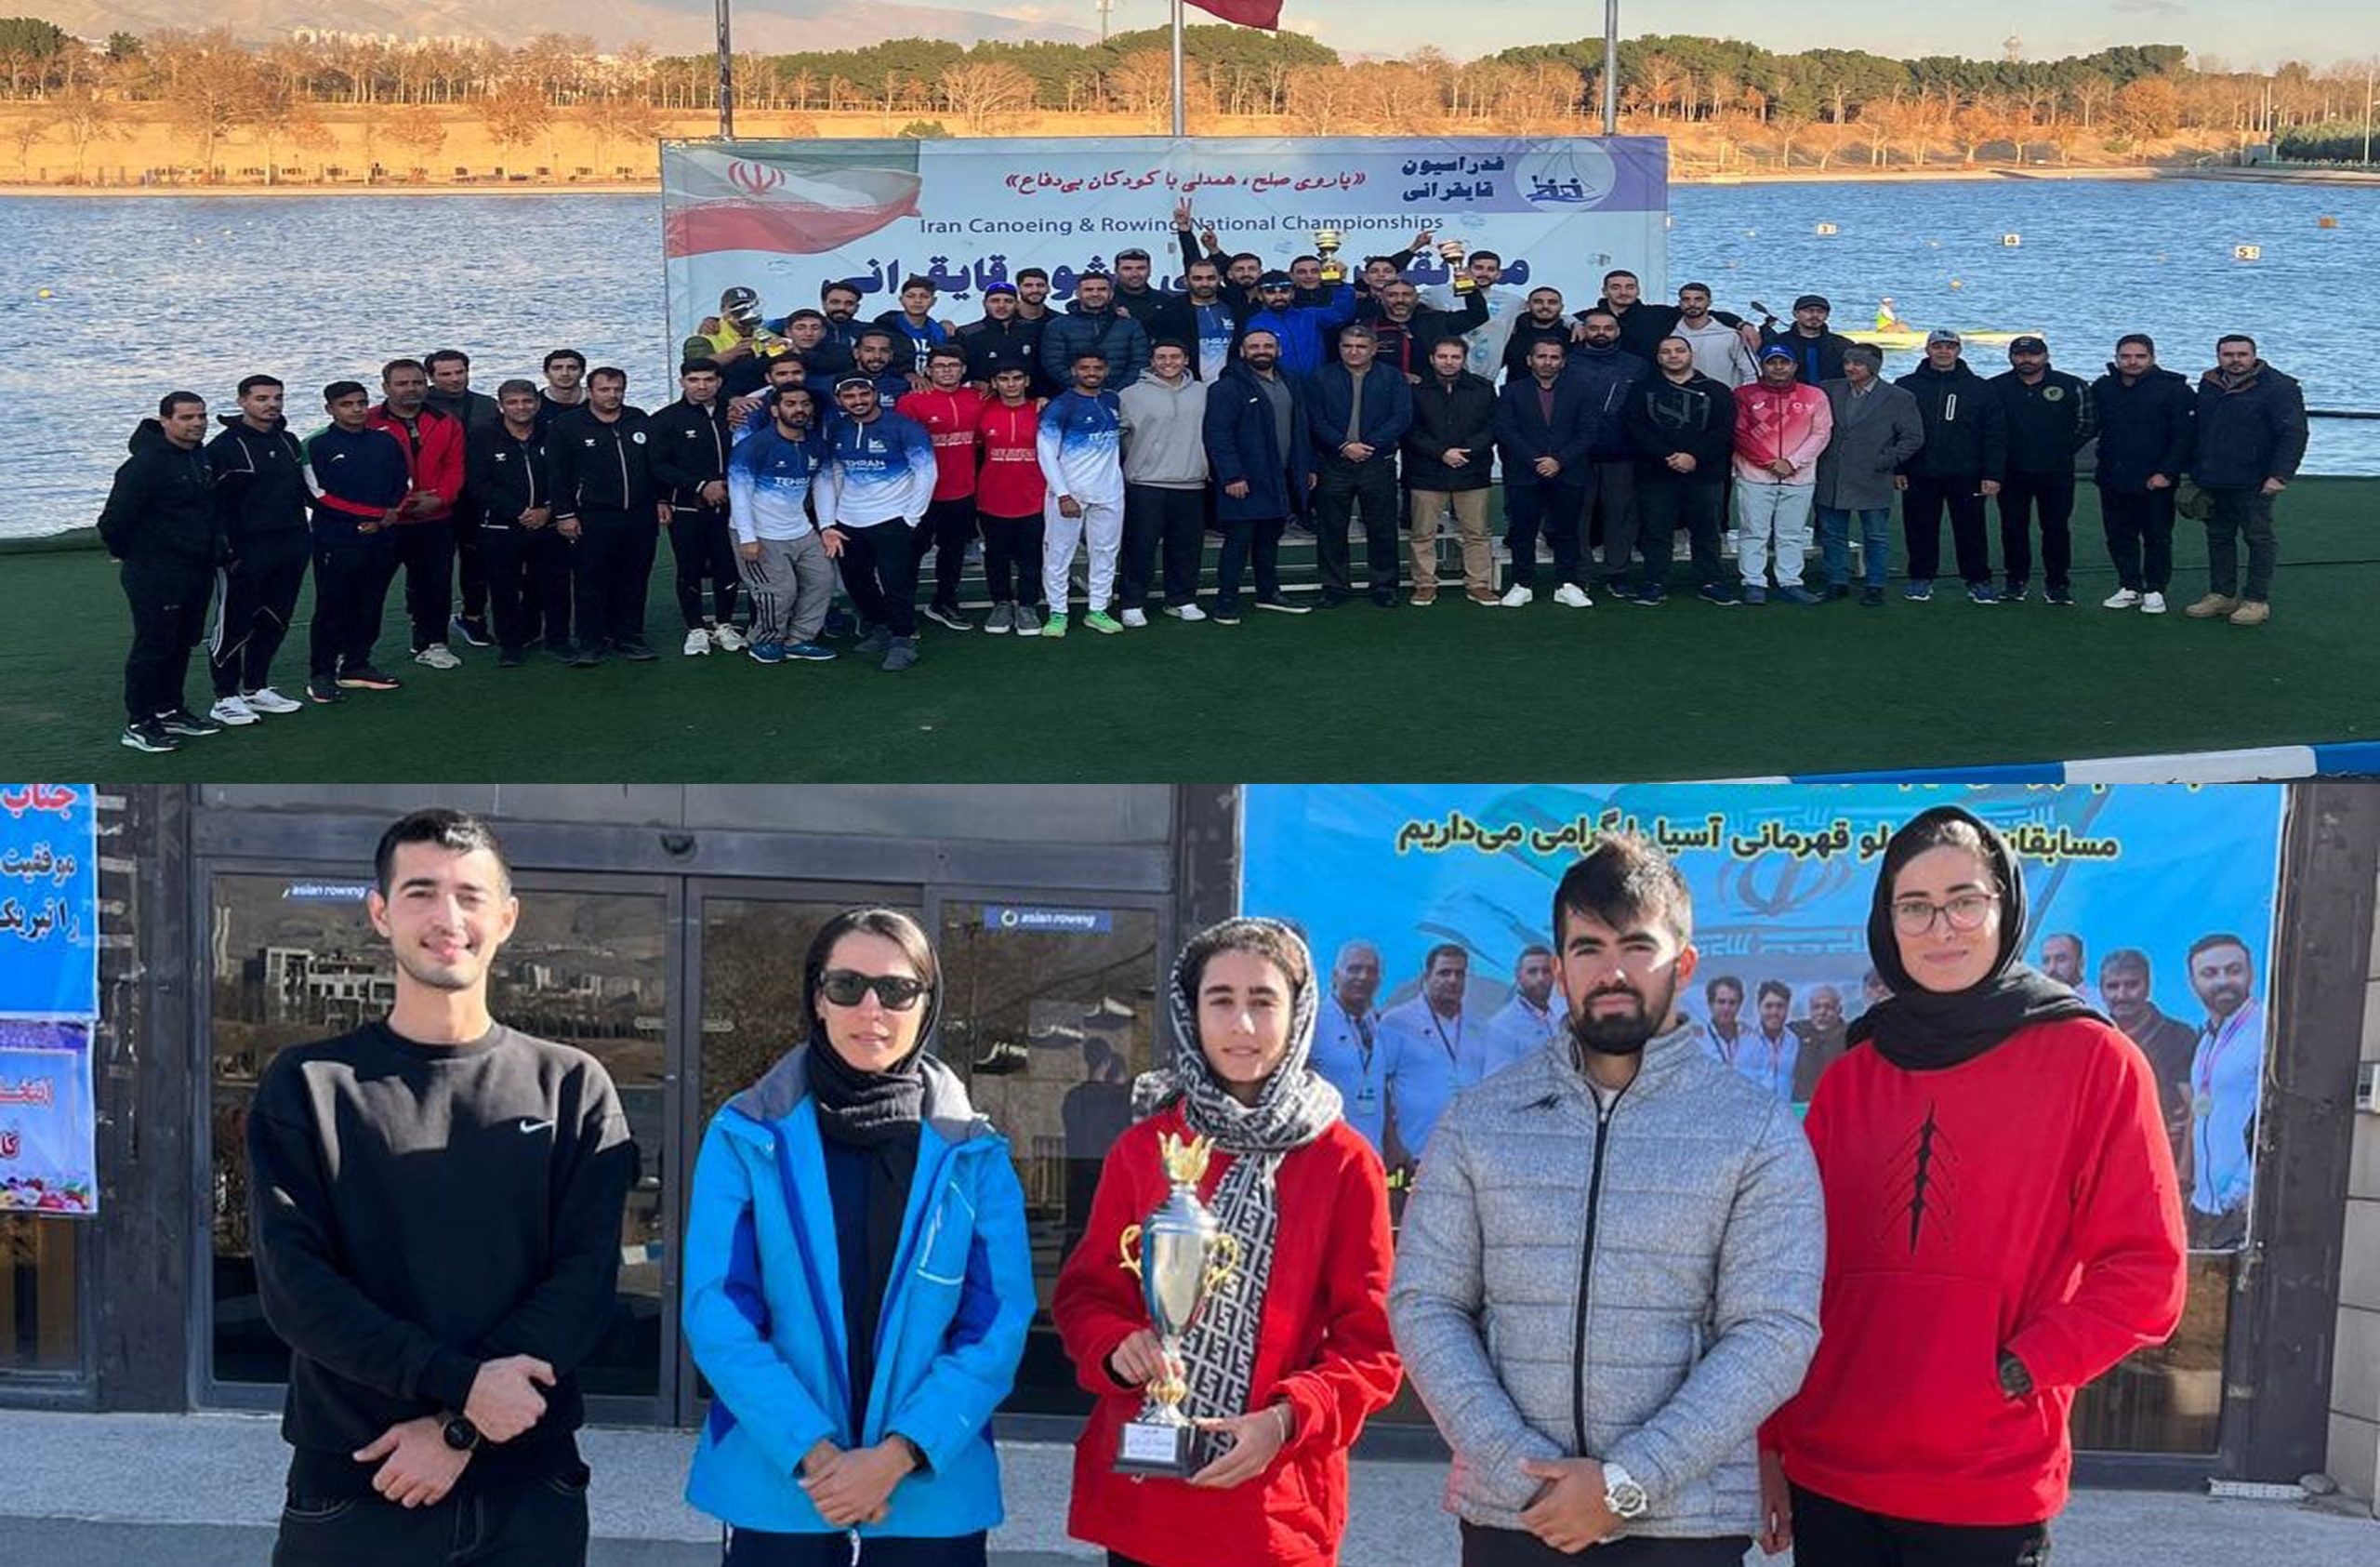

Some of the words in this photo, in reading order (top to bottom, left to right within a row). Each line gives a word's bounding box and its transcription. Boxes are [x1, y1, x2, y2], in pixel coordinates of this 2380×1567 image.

[1401, 155, 1505, 175] فدراسیون
[1088, 169, 1160, 191] کودکان
[1165, 171, 1178, 190] با
[1182, 172, 1236, 192] همدلی
[1402, 180, 1494, 201] قایقرانی
[920, 219, 961, 232] Iran
[969, 218, 1072, 235] Canoeing
[1079, 218, 1094, 232] &
[1282, 214, 1444, 232] Championships
[1658, 815, 1722, 855] آسیا
[1733, 819, 1850, 858] قهرمانی
